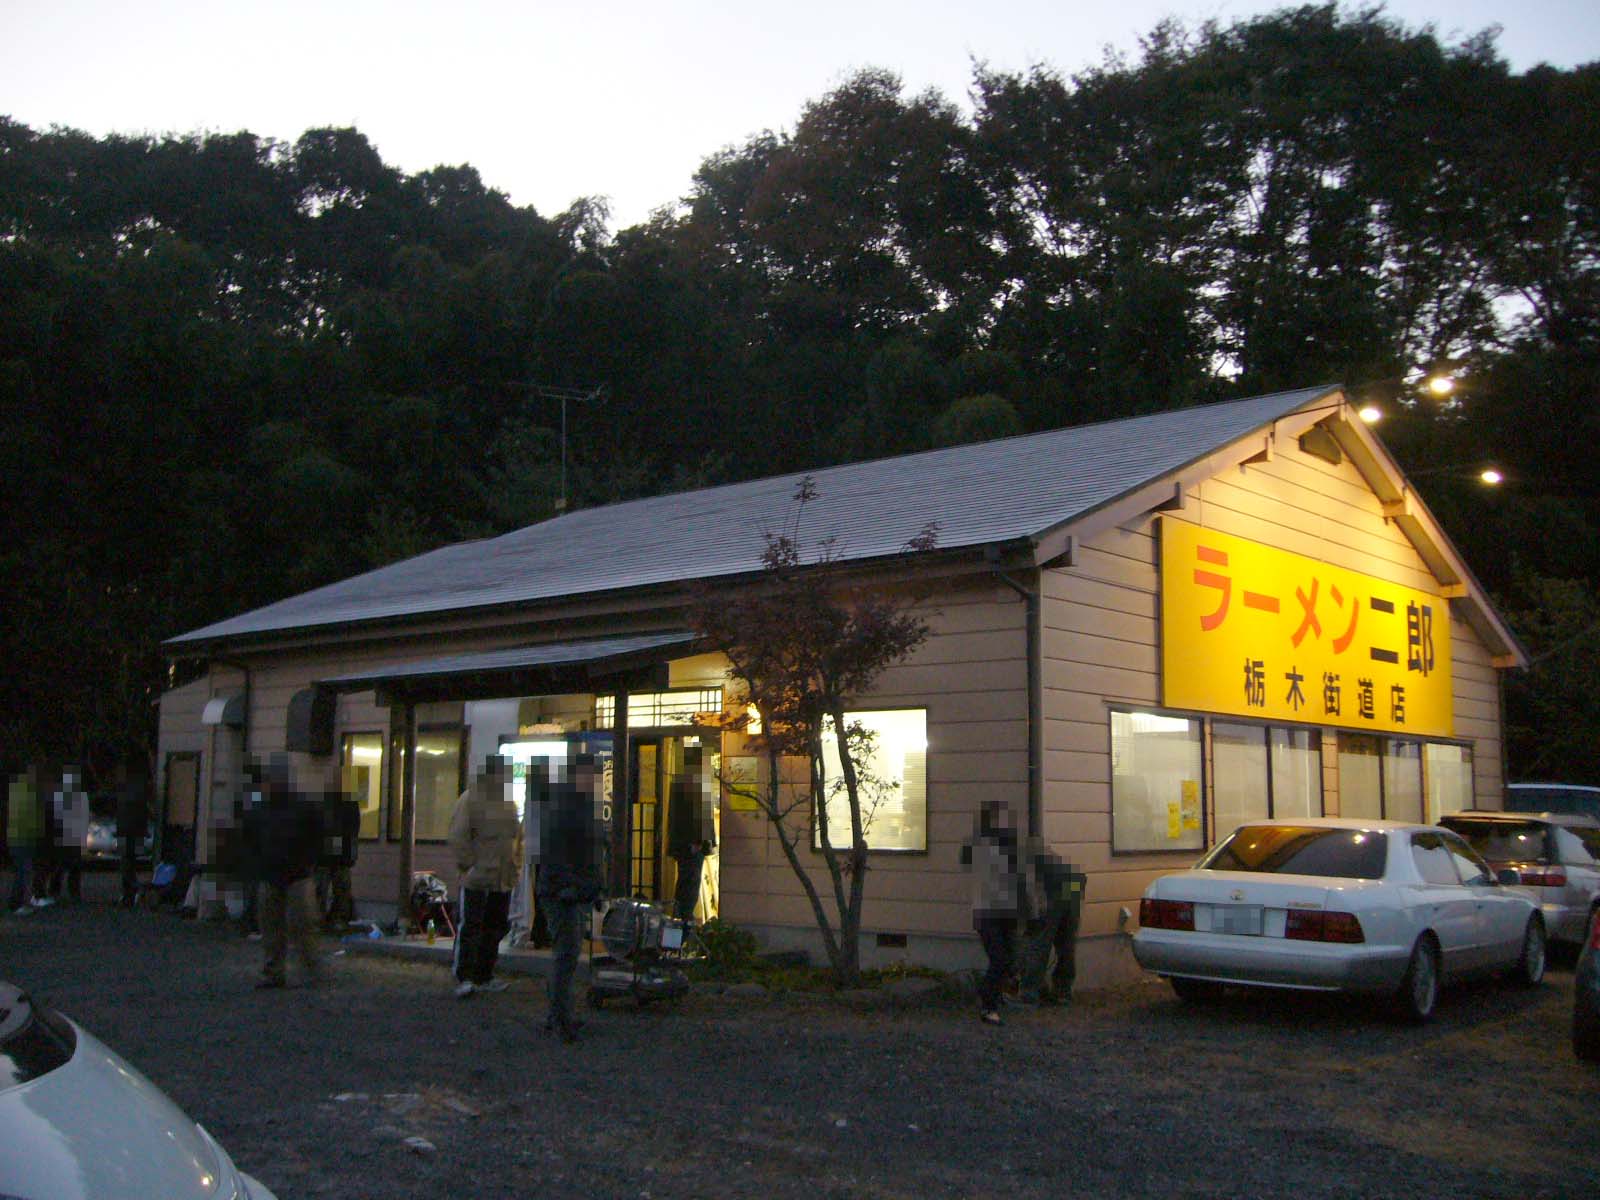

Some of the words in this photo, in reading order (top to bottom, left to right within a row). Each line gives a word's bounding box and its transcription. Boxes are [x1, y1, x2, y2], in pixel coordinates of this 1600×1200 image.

[1194, 546, 1433, 676] ラーメン二郎
[1244, 657, 1405, 724] 栃木街道店
